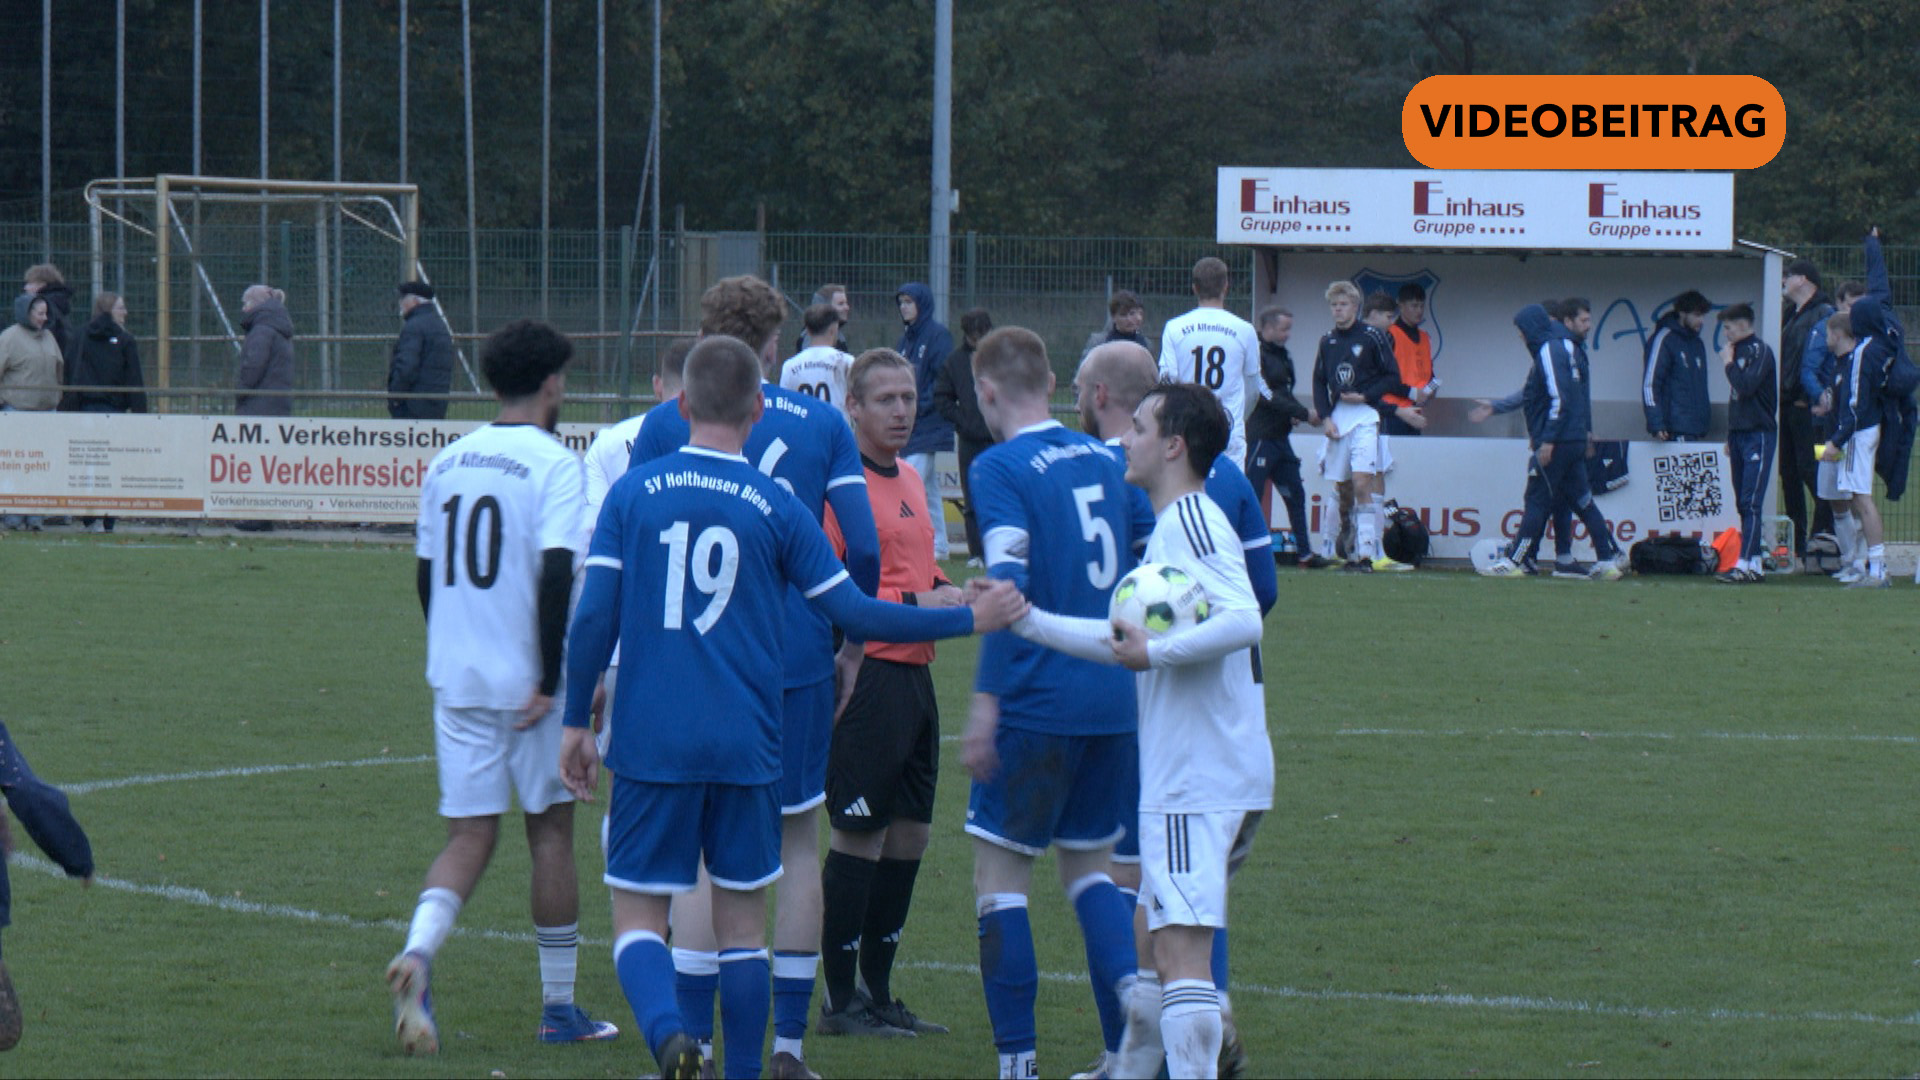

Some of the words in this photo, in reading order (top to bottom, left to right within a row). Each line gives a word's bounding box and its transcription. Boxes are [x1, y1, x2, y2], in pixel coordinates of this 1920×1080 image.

[1241, 178, 1350, 215] Einhaus
[1413, 180, 1525, 217] Einhaus
[1588, 182, 1701, 219] Einhaus
[1241, 217, 1301, 234] Gruppe
[1413, 219, 1475, 236] Gruppe
[1588, 221, 1651, 239] Gruppe
[1191, 345, 1226, 390] 18
[776, 397, 808, 418] Biene
[211, 423, 270, 445] A.M.
[210, 454, 252, 483] Die
[210, 495, 314, 510] Verkehrssicherung
[329, 497, 418, 511] Verkehrstechnik
[644, 475, 662, 494] SV
[665, 471, 740, 496] Holthausen
[740, 484, 772, 516] Biene
[442, 494, 502, 590] 10
[1072, 484, 1118, 590] 5
[659, 521, 739, 636] 19
